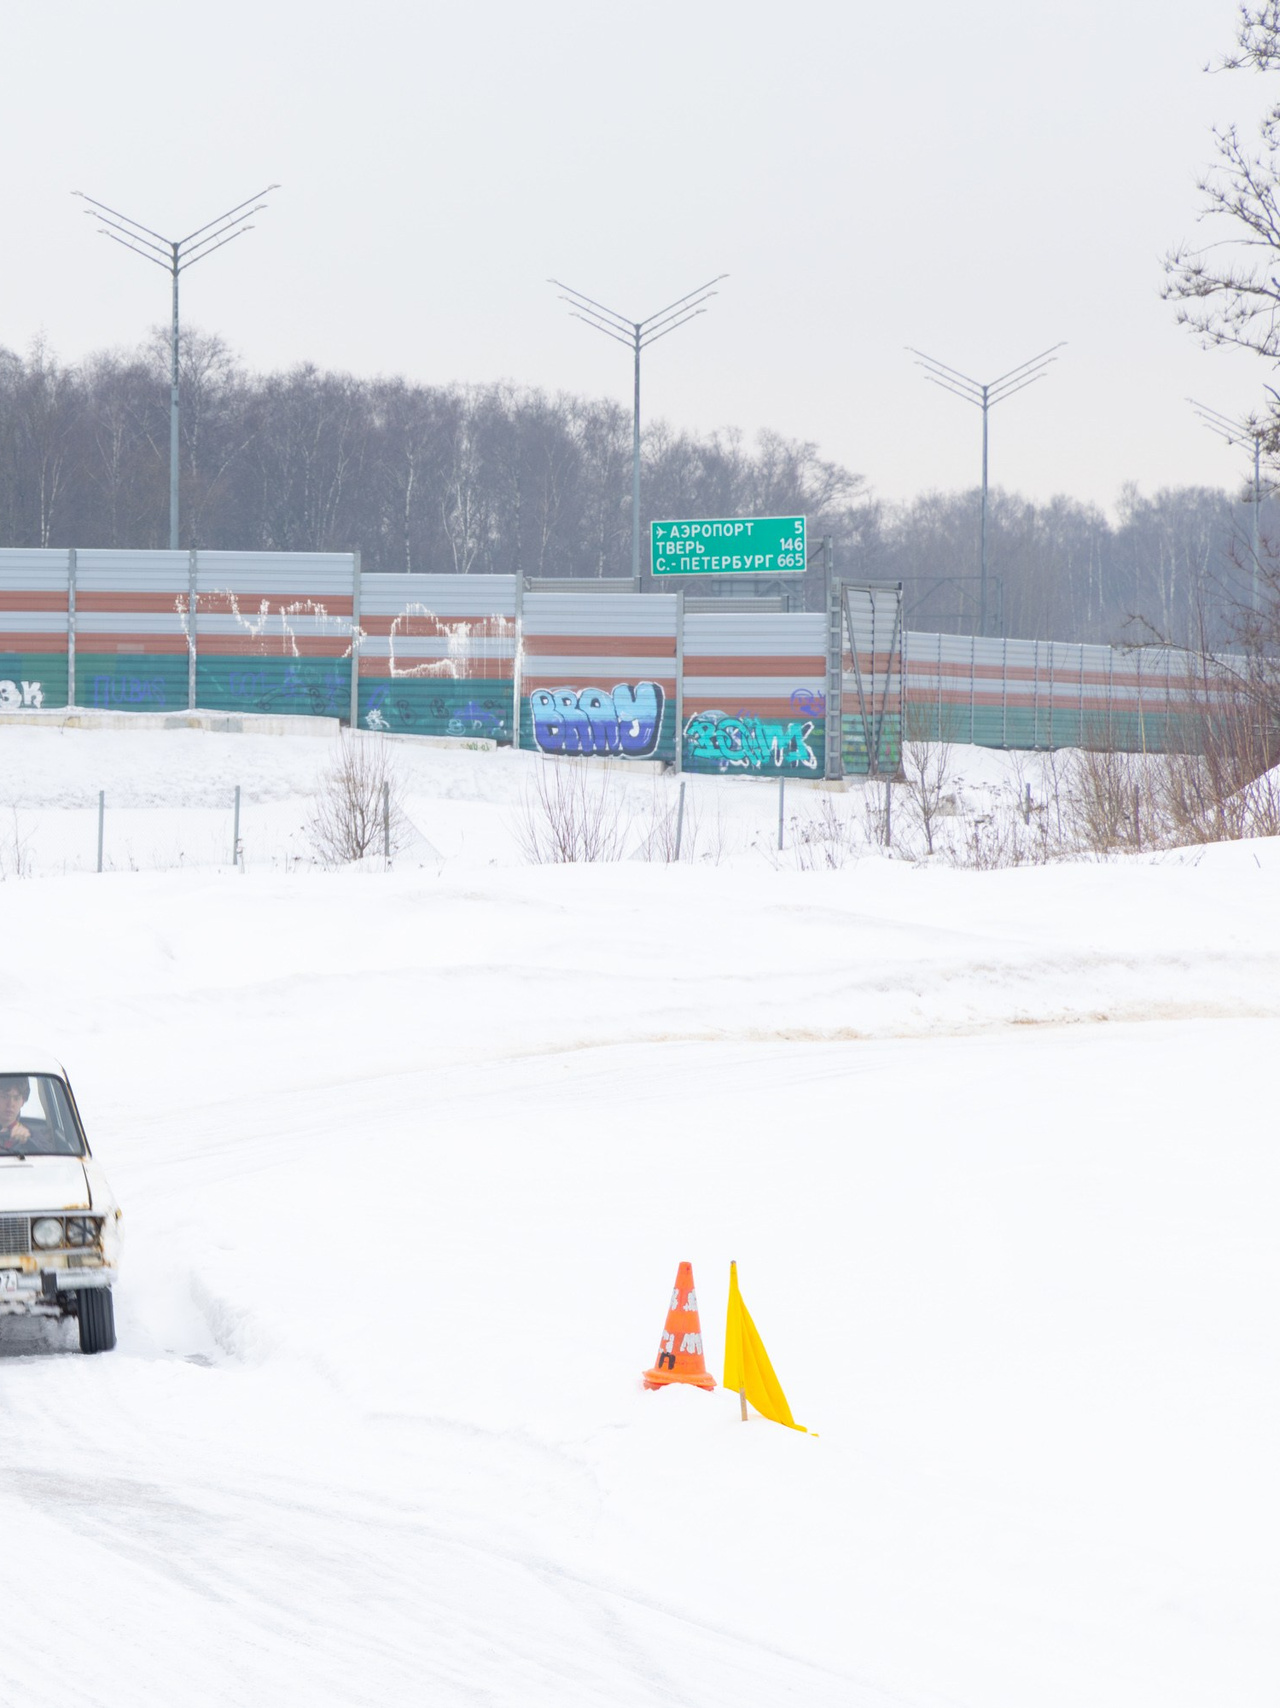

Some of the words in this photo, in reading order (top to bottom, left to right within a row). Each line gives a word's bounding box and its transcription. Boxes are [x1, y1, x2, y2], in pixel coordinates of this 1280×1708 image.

[670, 523, 754, 538] АЭРОПОРТ
[794, 521, 803, 534] 5
[656, 541, 705, 554] ТВЕРЬ
[779, 538, 803, 551] 146
[777, 553, 804, 568] 665
